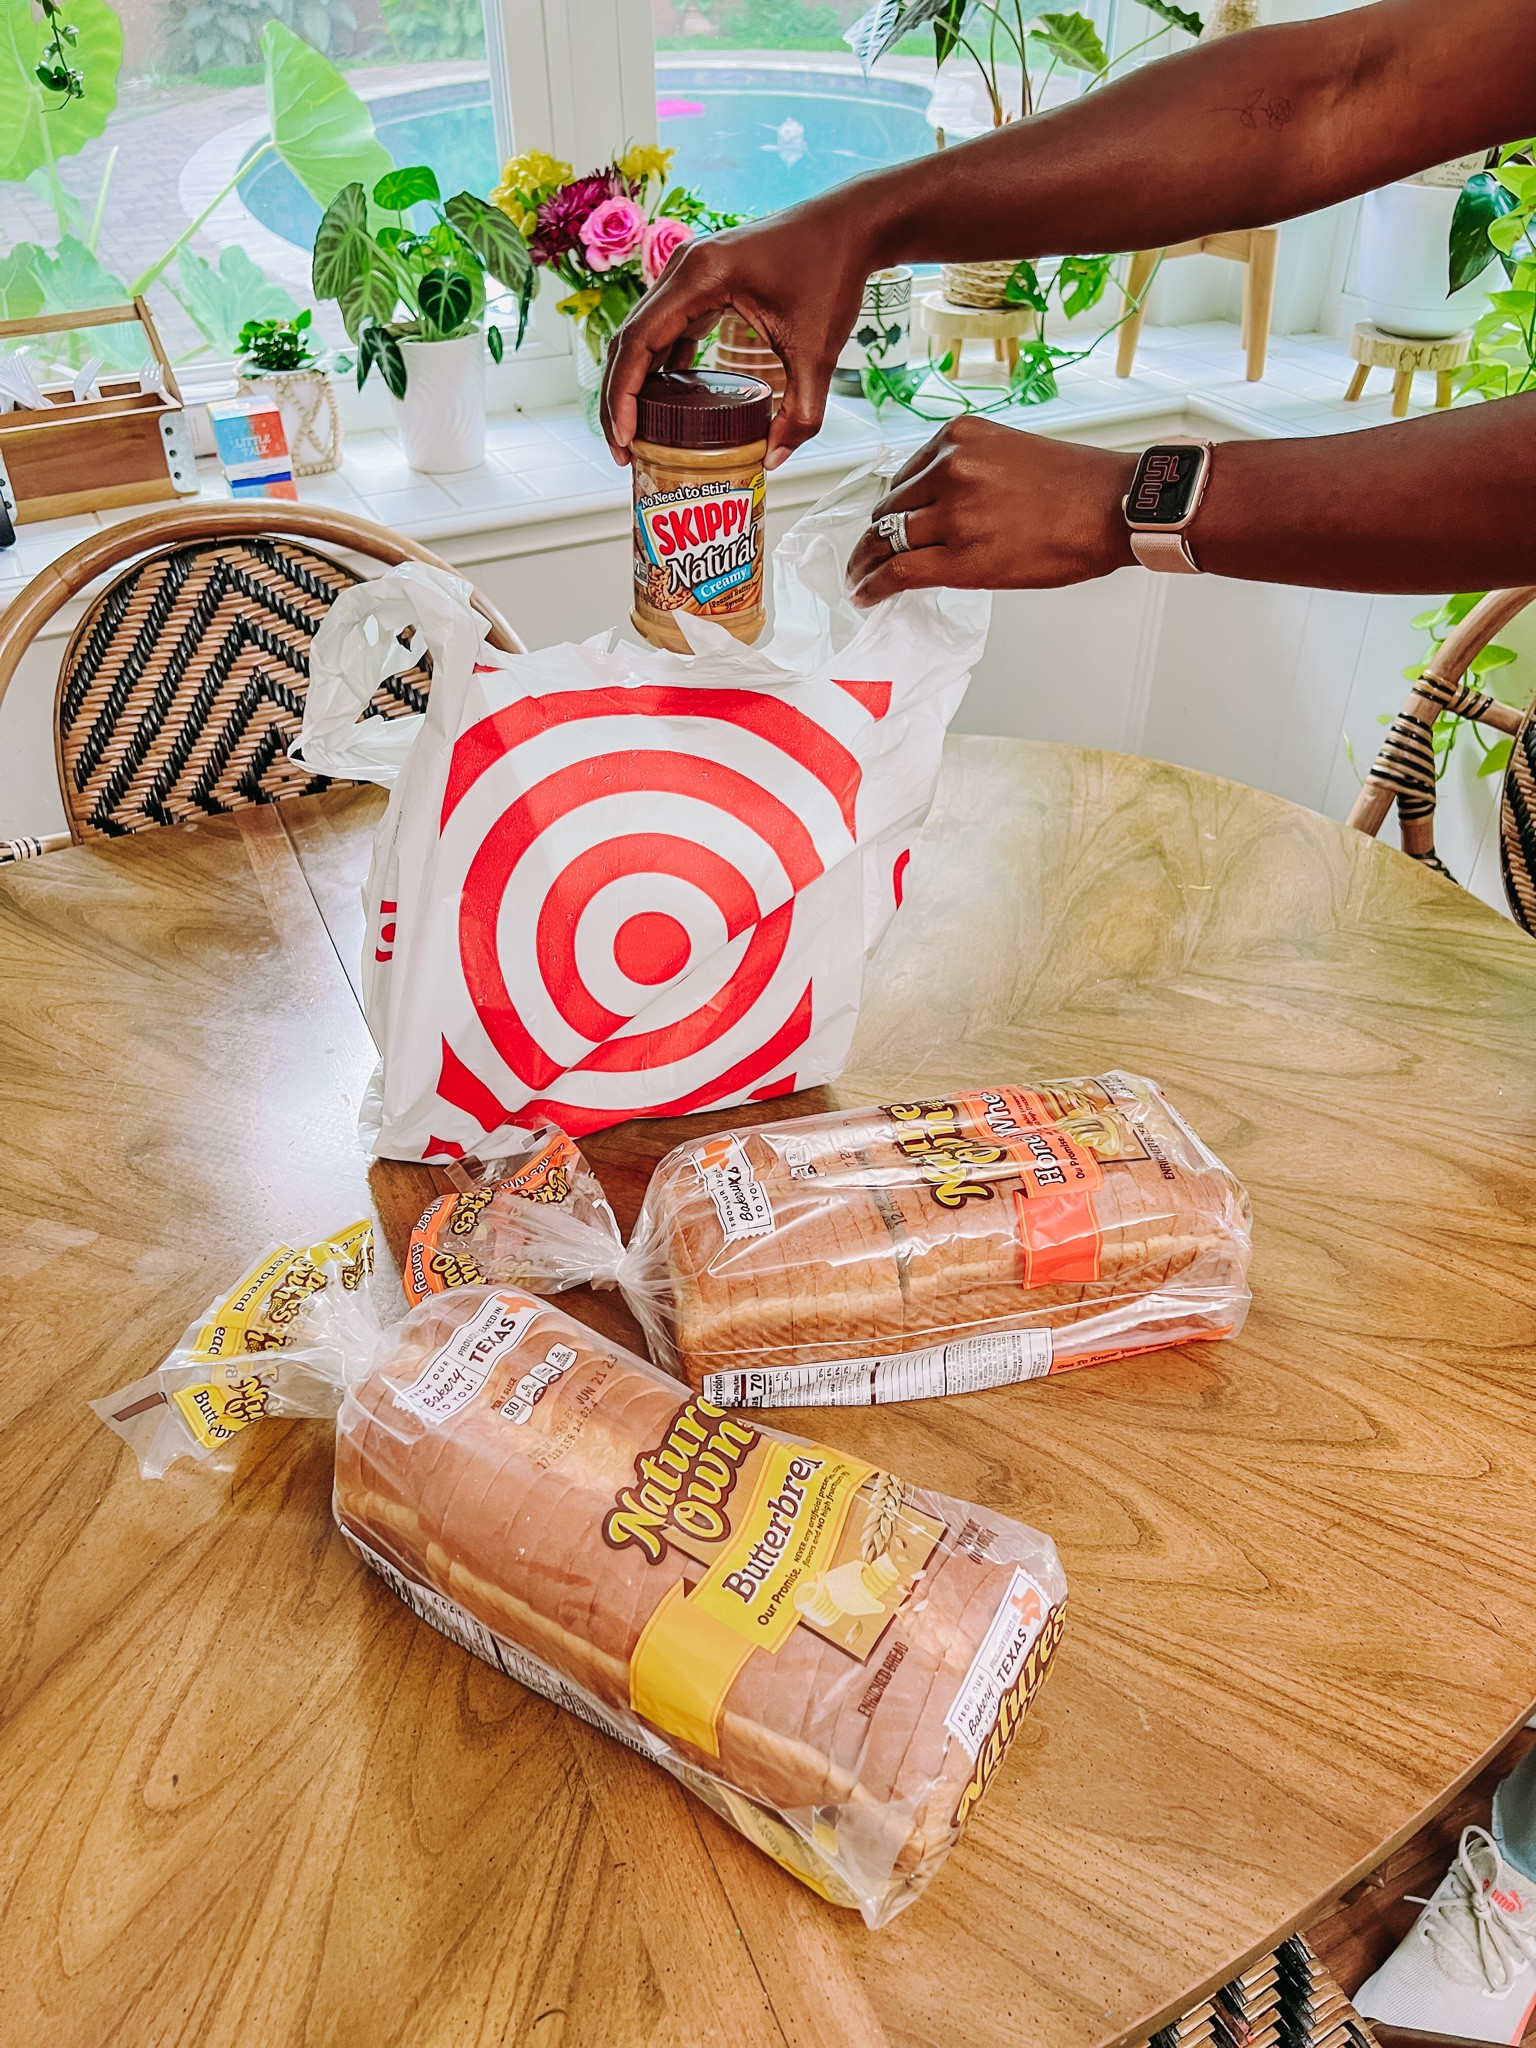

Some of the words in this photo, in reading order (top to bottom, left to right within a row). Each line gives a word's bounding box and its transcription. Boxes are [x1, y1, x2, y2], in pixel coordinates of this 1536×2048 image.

[641, 497, 654, 509] No
[653, 489, 685, 505] Need
[685, 485, 701, 499] to
[701, 481, 731, 497] Stir!
[652, 498, 750, 556] SKIPPY
[666, 523, 758, 595] Natural
[700, 567, 748, 598] Creamy
[711, 589, 734, 608] Peanut
[734, 583, 752, 597] Butter
[978, 1091, 1020, 1137] Whe
[1012, 1131, 1066, 1186] Hone
[755, 1204, 764, 1217] TO
[410, 1241, 426, 1292] Honey
[433, 1249, 465, 1290] Ow
[467, 1315, 517, 1366] TEXAS
[421, 1366, 467, 1409] Bakery
[431, 1359, 450, 1381] OUR
[749, 1373, 762, 1391] 70
[436, 1402, 451, 1414] TO
[451, 1377, 477, 1403] YOU!
[490, 1397, 502, 1411] PER
[501, 1375, 518, 1395] SLICE
[503, 1400, 520, 1417] 60
[549, 1419, 570, 1443] USED
[563, 1405, 577, 1419] BY
[574, 1383, 596, 1406] JUN
[589, 1367, 608, 1387] 21
[601, 1352, 618, 1370] 23
[711, 1374, 722, 1406] utrición
[535, 1455, 551, 1471] 17
[676, 1419, 756, 1538] Own
[806, 1496, 824, 1527] artificial
[815, 1516, 826, 1530] NO
[819, 1499, 833, 1517] high
[719, 1454, 823, 1603] Butterbre
[801, 1526, 815, 1541] any
[811, 1529, 822, 1544] and
[792, 1540, 808, 1562] NEVER
[801, 1542, 818, 1567] flavors
[755, 1602, 778, 1628] Our
[771, 1565, 802, 1604] Promise.
[993, 1627, 1030, 1683] TEXAS
[857, 1669, 892, 1718] ENRICHED
[885, 1641, 909, 1675] BREAD
[955, 1695, 976, 1723] FROM
[970, 1673, 987, 1694] OUR
[951, 1599, 1067, 1824] Nature's
[962, 1682, 997, 1736] Bakery
